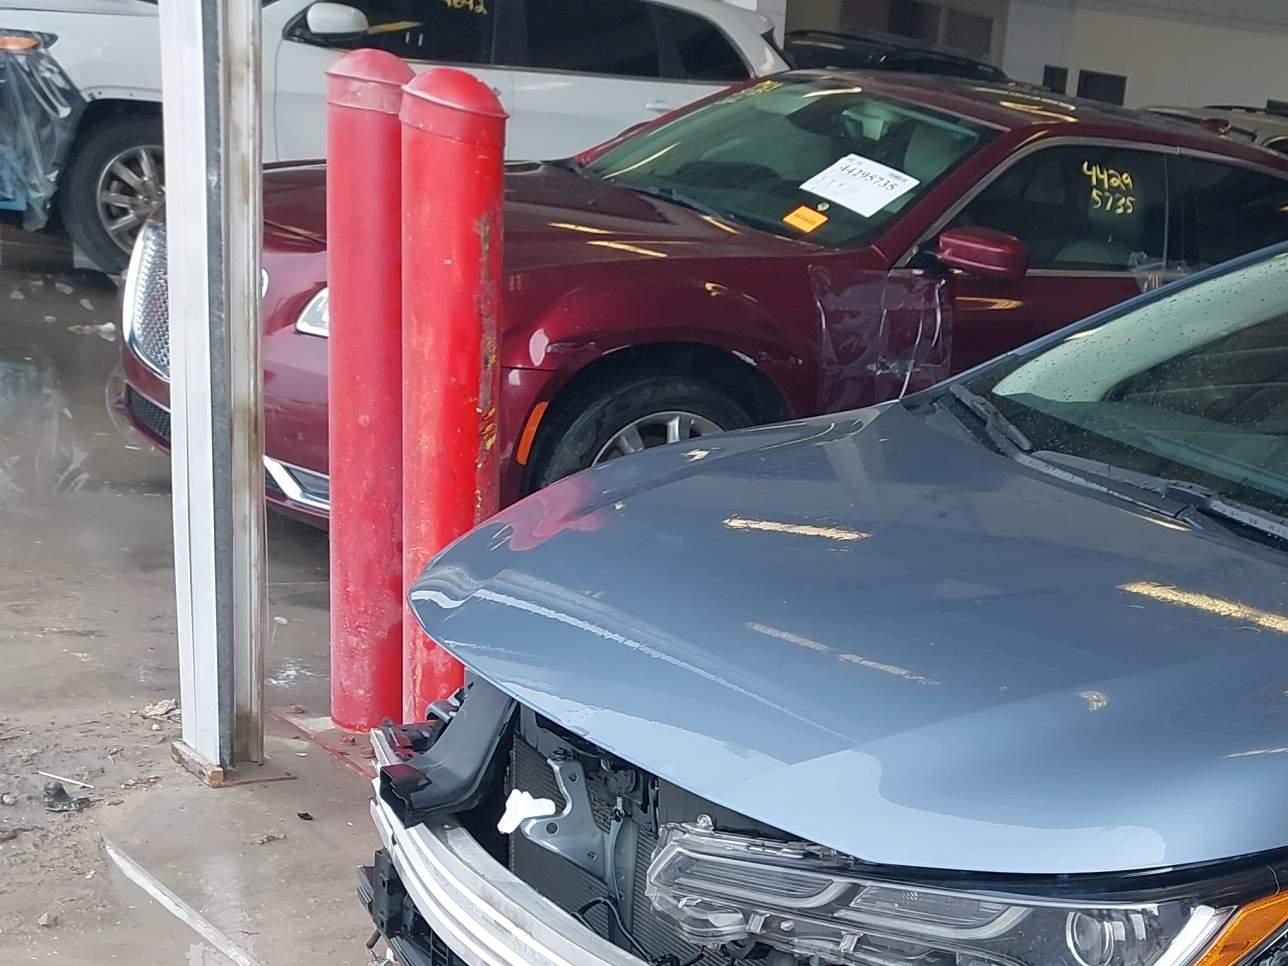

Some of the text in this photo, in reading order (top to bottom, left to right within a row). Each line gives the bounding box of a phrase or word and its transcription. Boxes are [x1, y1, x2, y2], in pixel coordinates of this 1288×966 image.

[839, 164, 899, 192] 44295735
[1082, 160, 1133, 190] 4429
[1091, 187, 1136, 214] 5735
